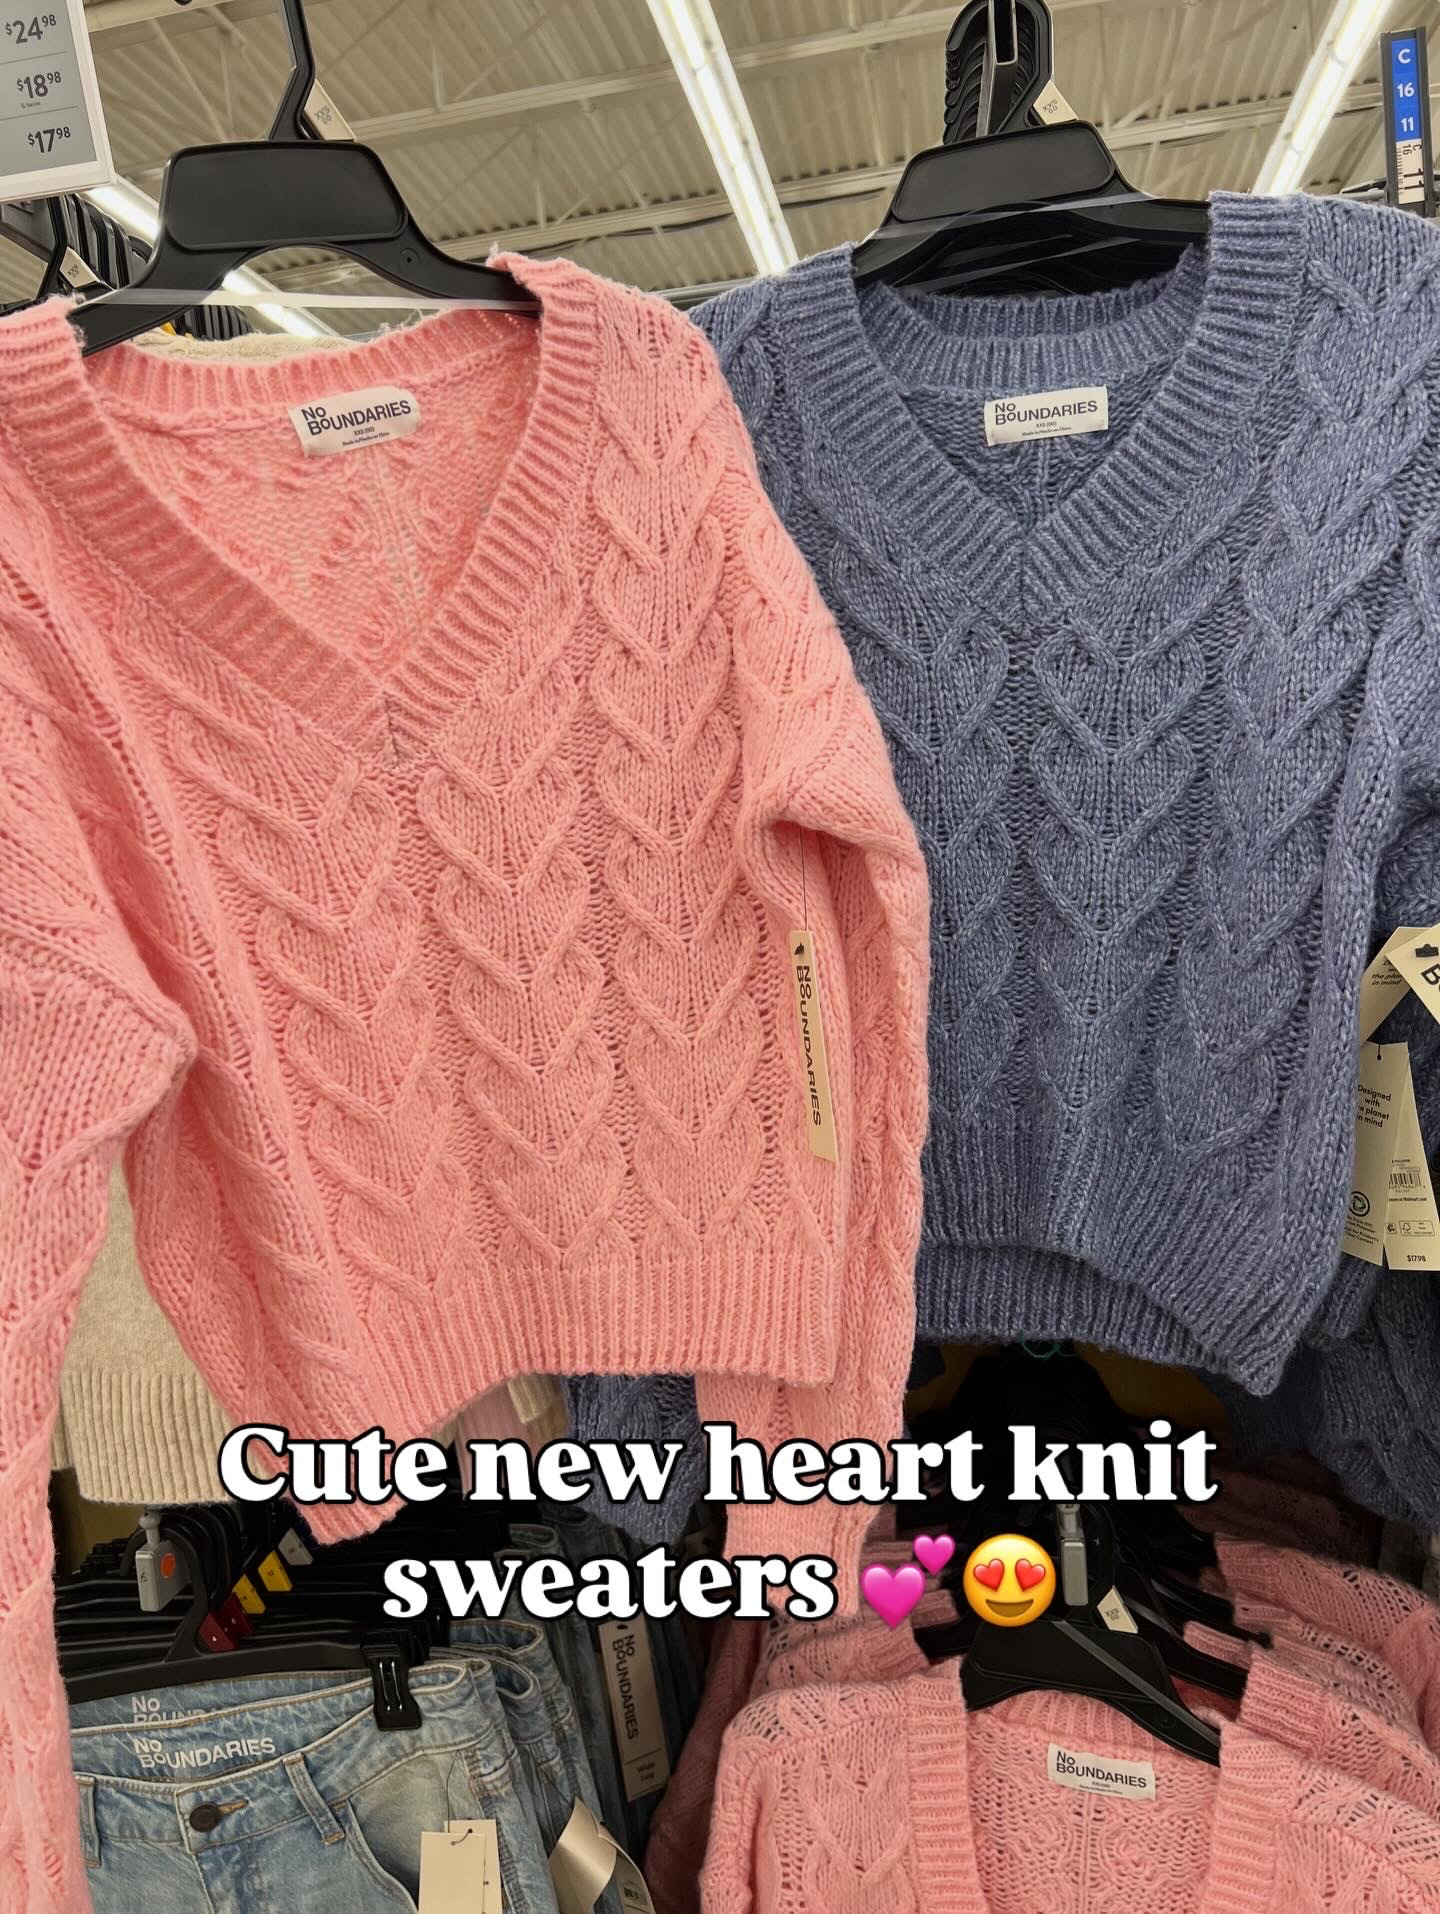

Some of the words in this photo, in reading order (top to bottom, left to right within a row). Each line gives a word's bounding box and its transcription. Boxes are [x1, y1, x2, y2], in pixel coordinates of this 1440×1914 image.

[1398, 48, 1411, 64] C
[1397, 82, 1415, 98] 16
[1401, 117, 1414, 132] 11
[1402, 144, 1412, 155] 16
[1357, 1084, 1392, 1102] Designed
[1364, 1098, 1380, 1108] with
[1365, 1107, 1390, 1120] planet
[1364, 1116, 1384, 1128] mind
